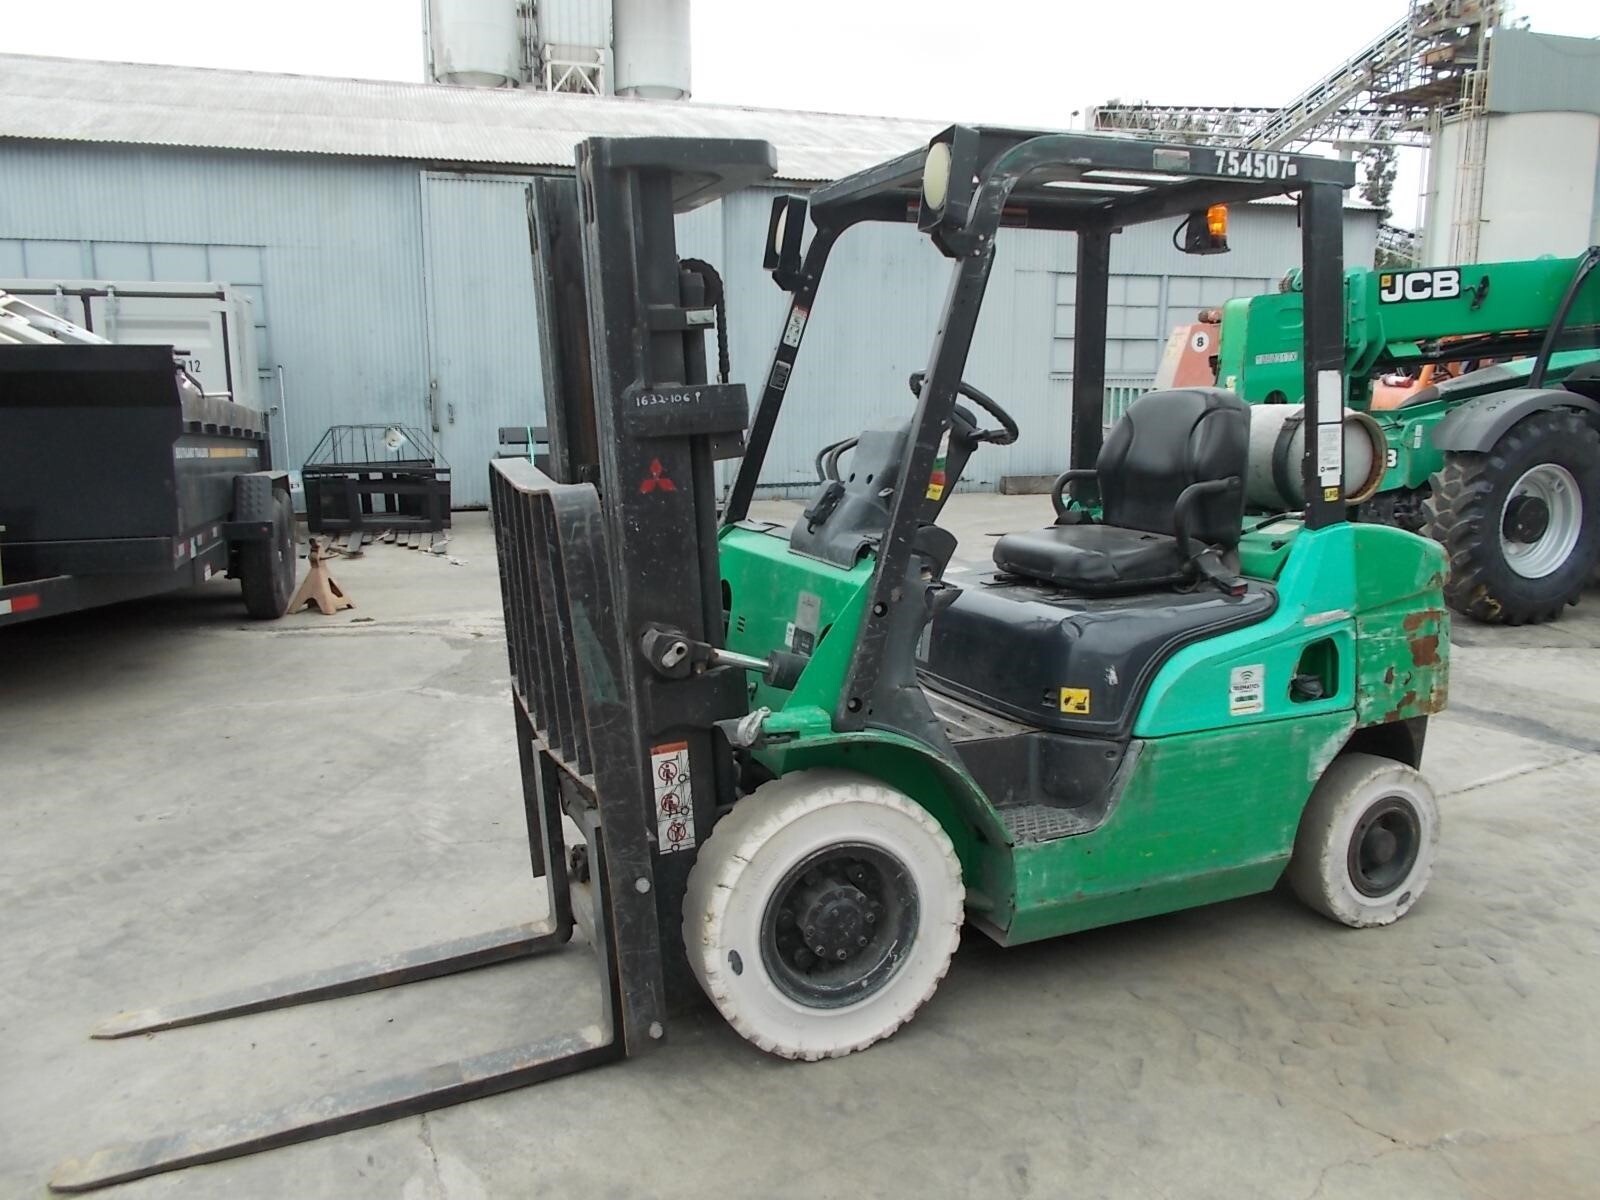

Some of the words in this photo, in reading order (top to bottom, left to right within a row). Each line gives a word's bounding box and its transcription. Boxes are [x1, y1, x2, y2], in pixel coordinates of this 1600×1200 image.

[1215, 150, 1290, 180] 754507
[1381, 270, 1460, 302] JCB
[1196, 336, 1204, 347] 8
[188, 359, 201, 372] 12
